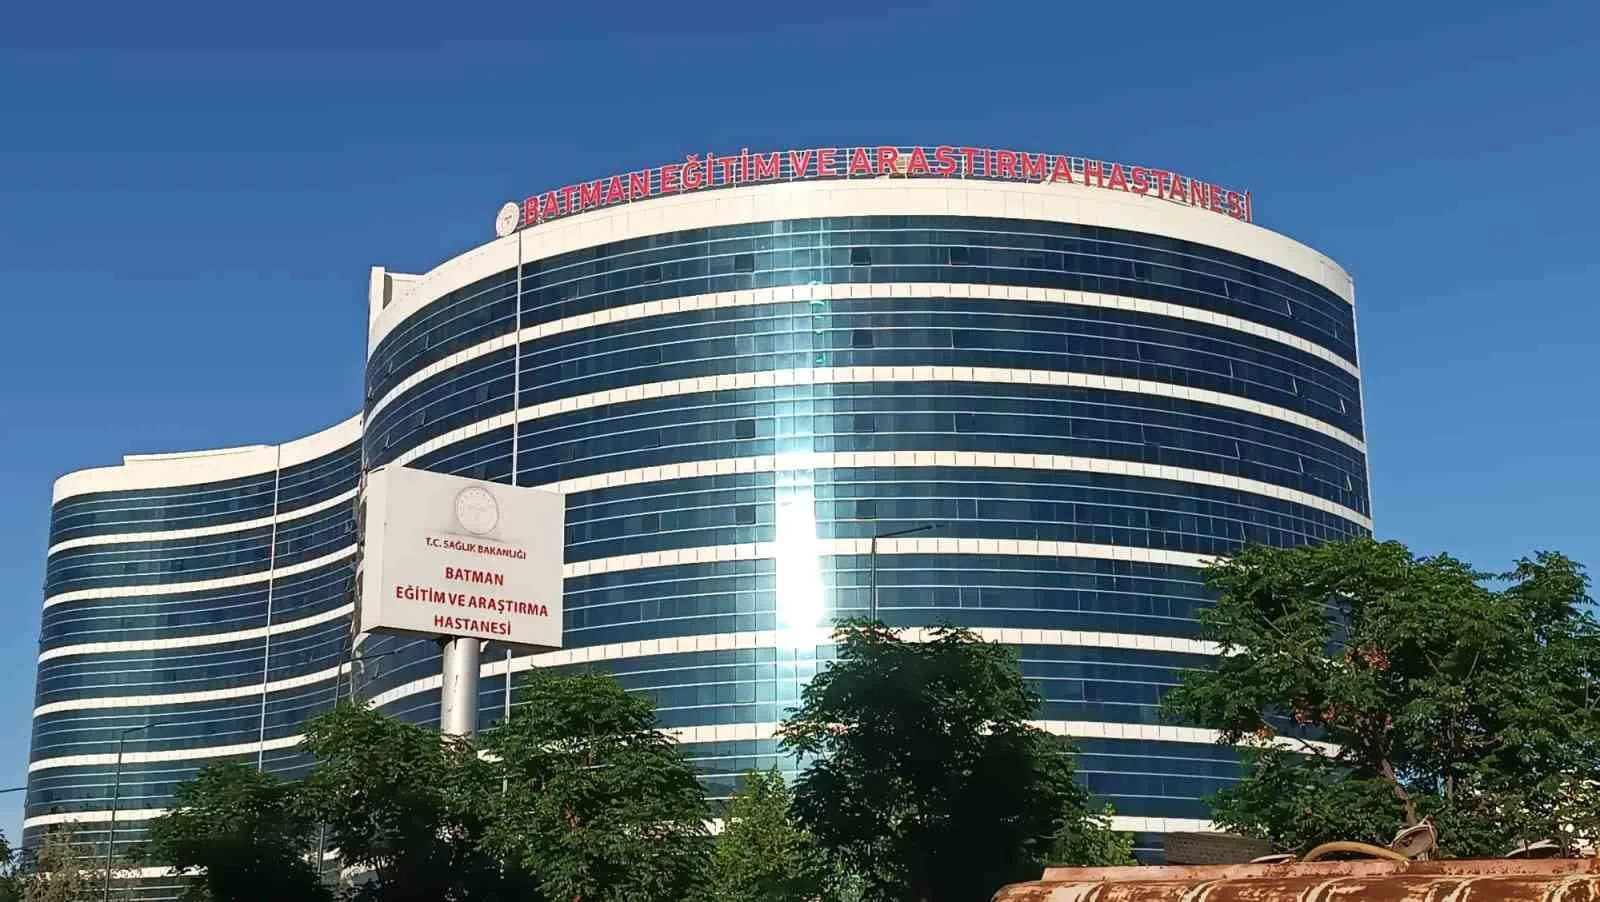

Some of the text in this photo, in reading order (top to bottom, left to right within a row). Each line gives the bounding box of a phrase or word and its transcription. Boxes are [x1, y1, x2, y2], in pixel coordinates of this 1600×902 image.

[523, 170, 652, 225] BATMAN
[659, 148, 782, 193] EĞİTİM
[788, 150, 836, 178] VE
[849, 145, 1074, 185] ARAŞTIRMA
[425, 537, 527, 560] T.C. SAĞLIK BAKANLIĞI
[445, 566, 504, 586] BATMAN
[395, 586, 549, 617] EĞİTİM VE ARAŞTIRMA
[434, 614, 512, 636] HASTANESİ
